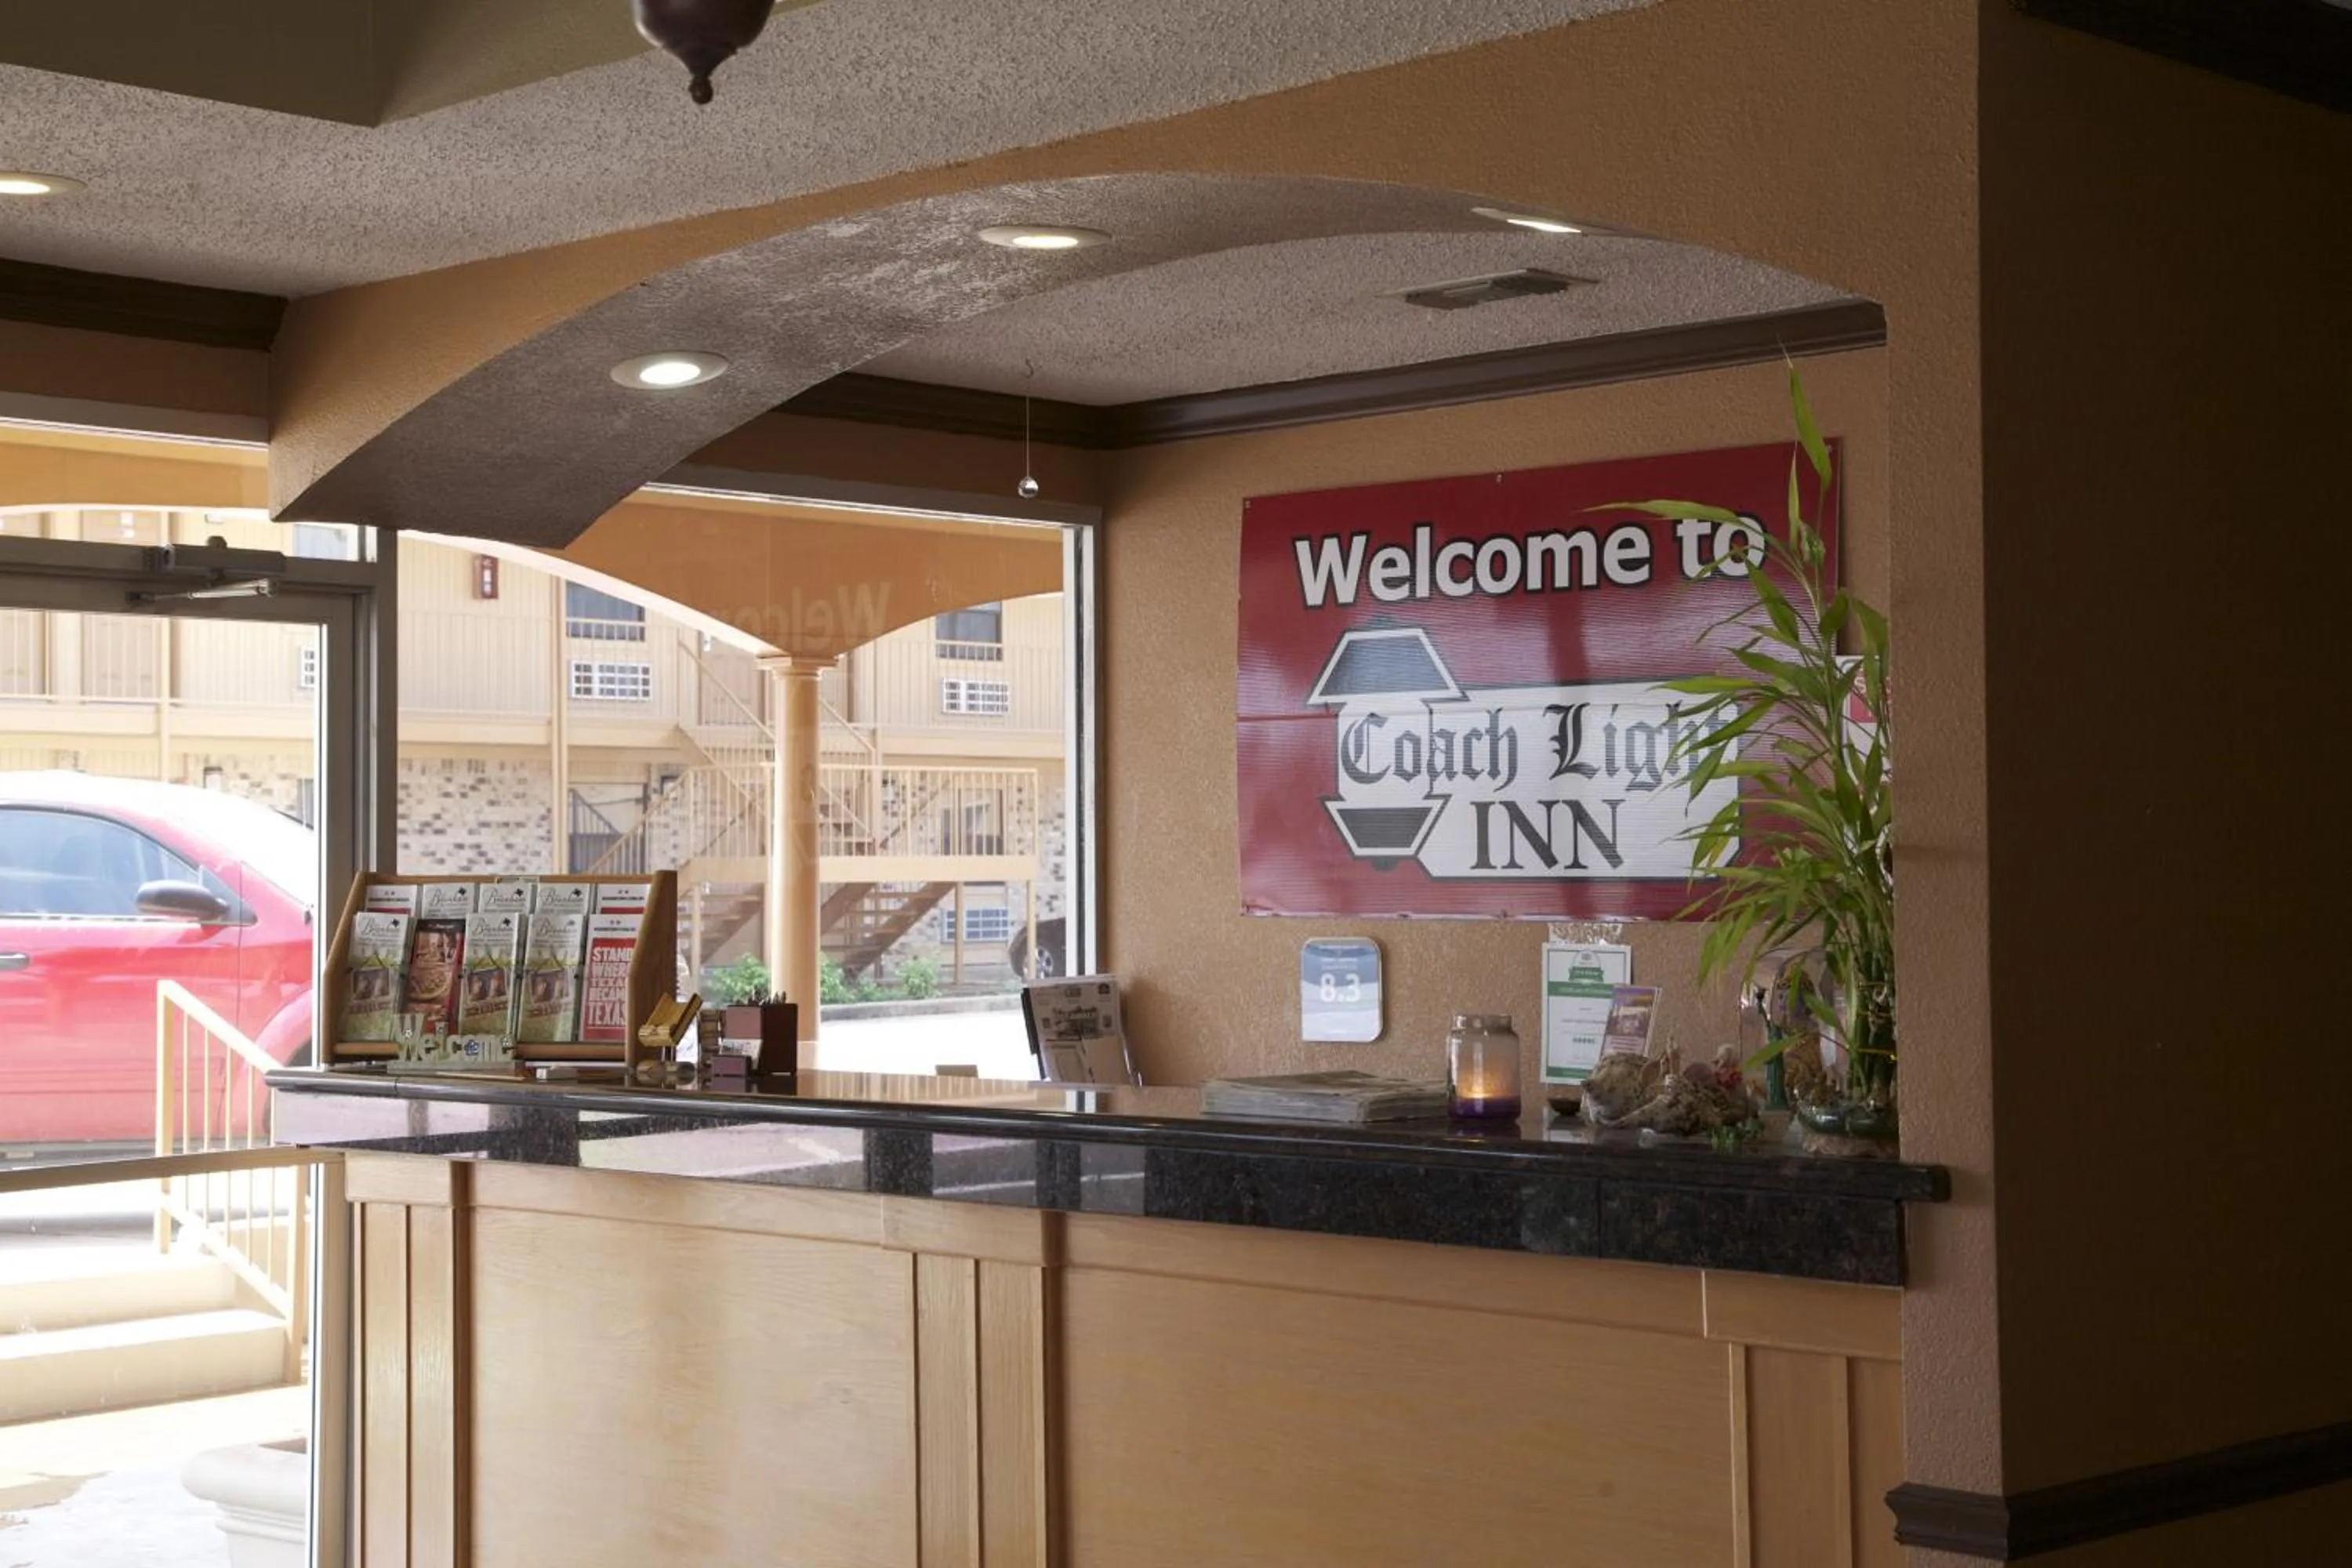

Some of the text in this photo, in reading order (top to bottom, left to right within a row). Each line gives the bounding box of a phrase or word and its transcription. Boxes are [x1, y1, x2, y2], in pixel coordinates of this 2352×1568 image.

[1294, 514, 1766, 607] Welcome to
[1341, 707, 1519, 793] Coach
[1471, 799, 1625, 871] INN
[1320, 972, 1360, 1003] 8.3
